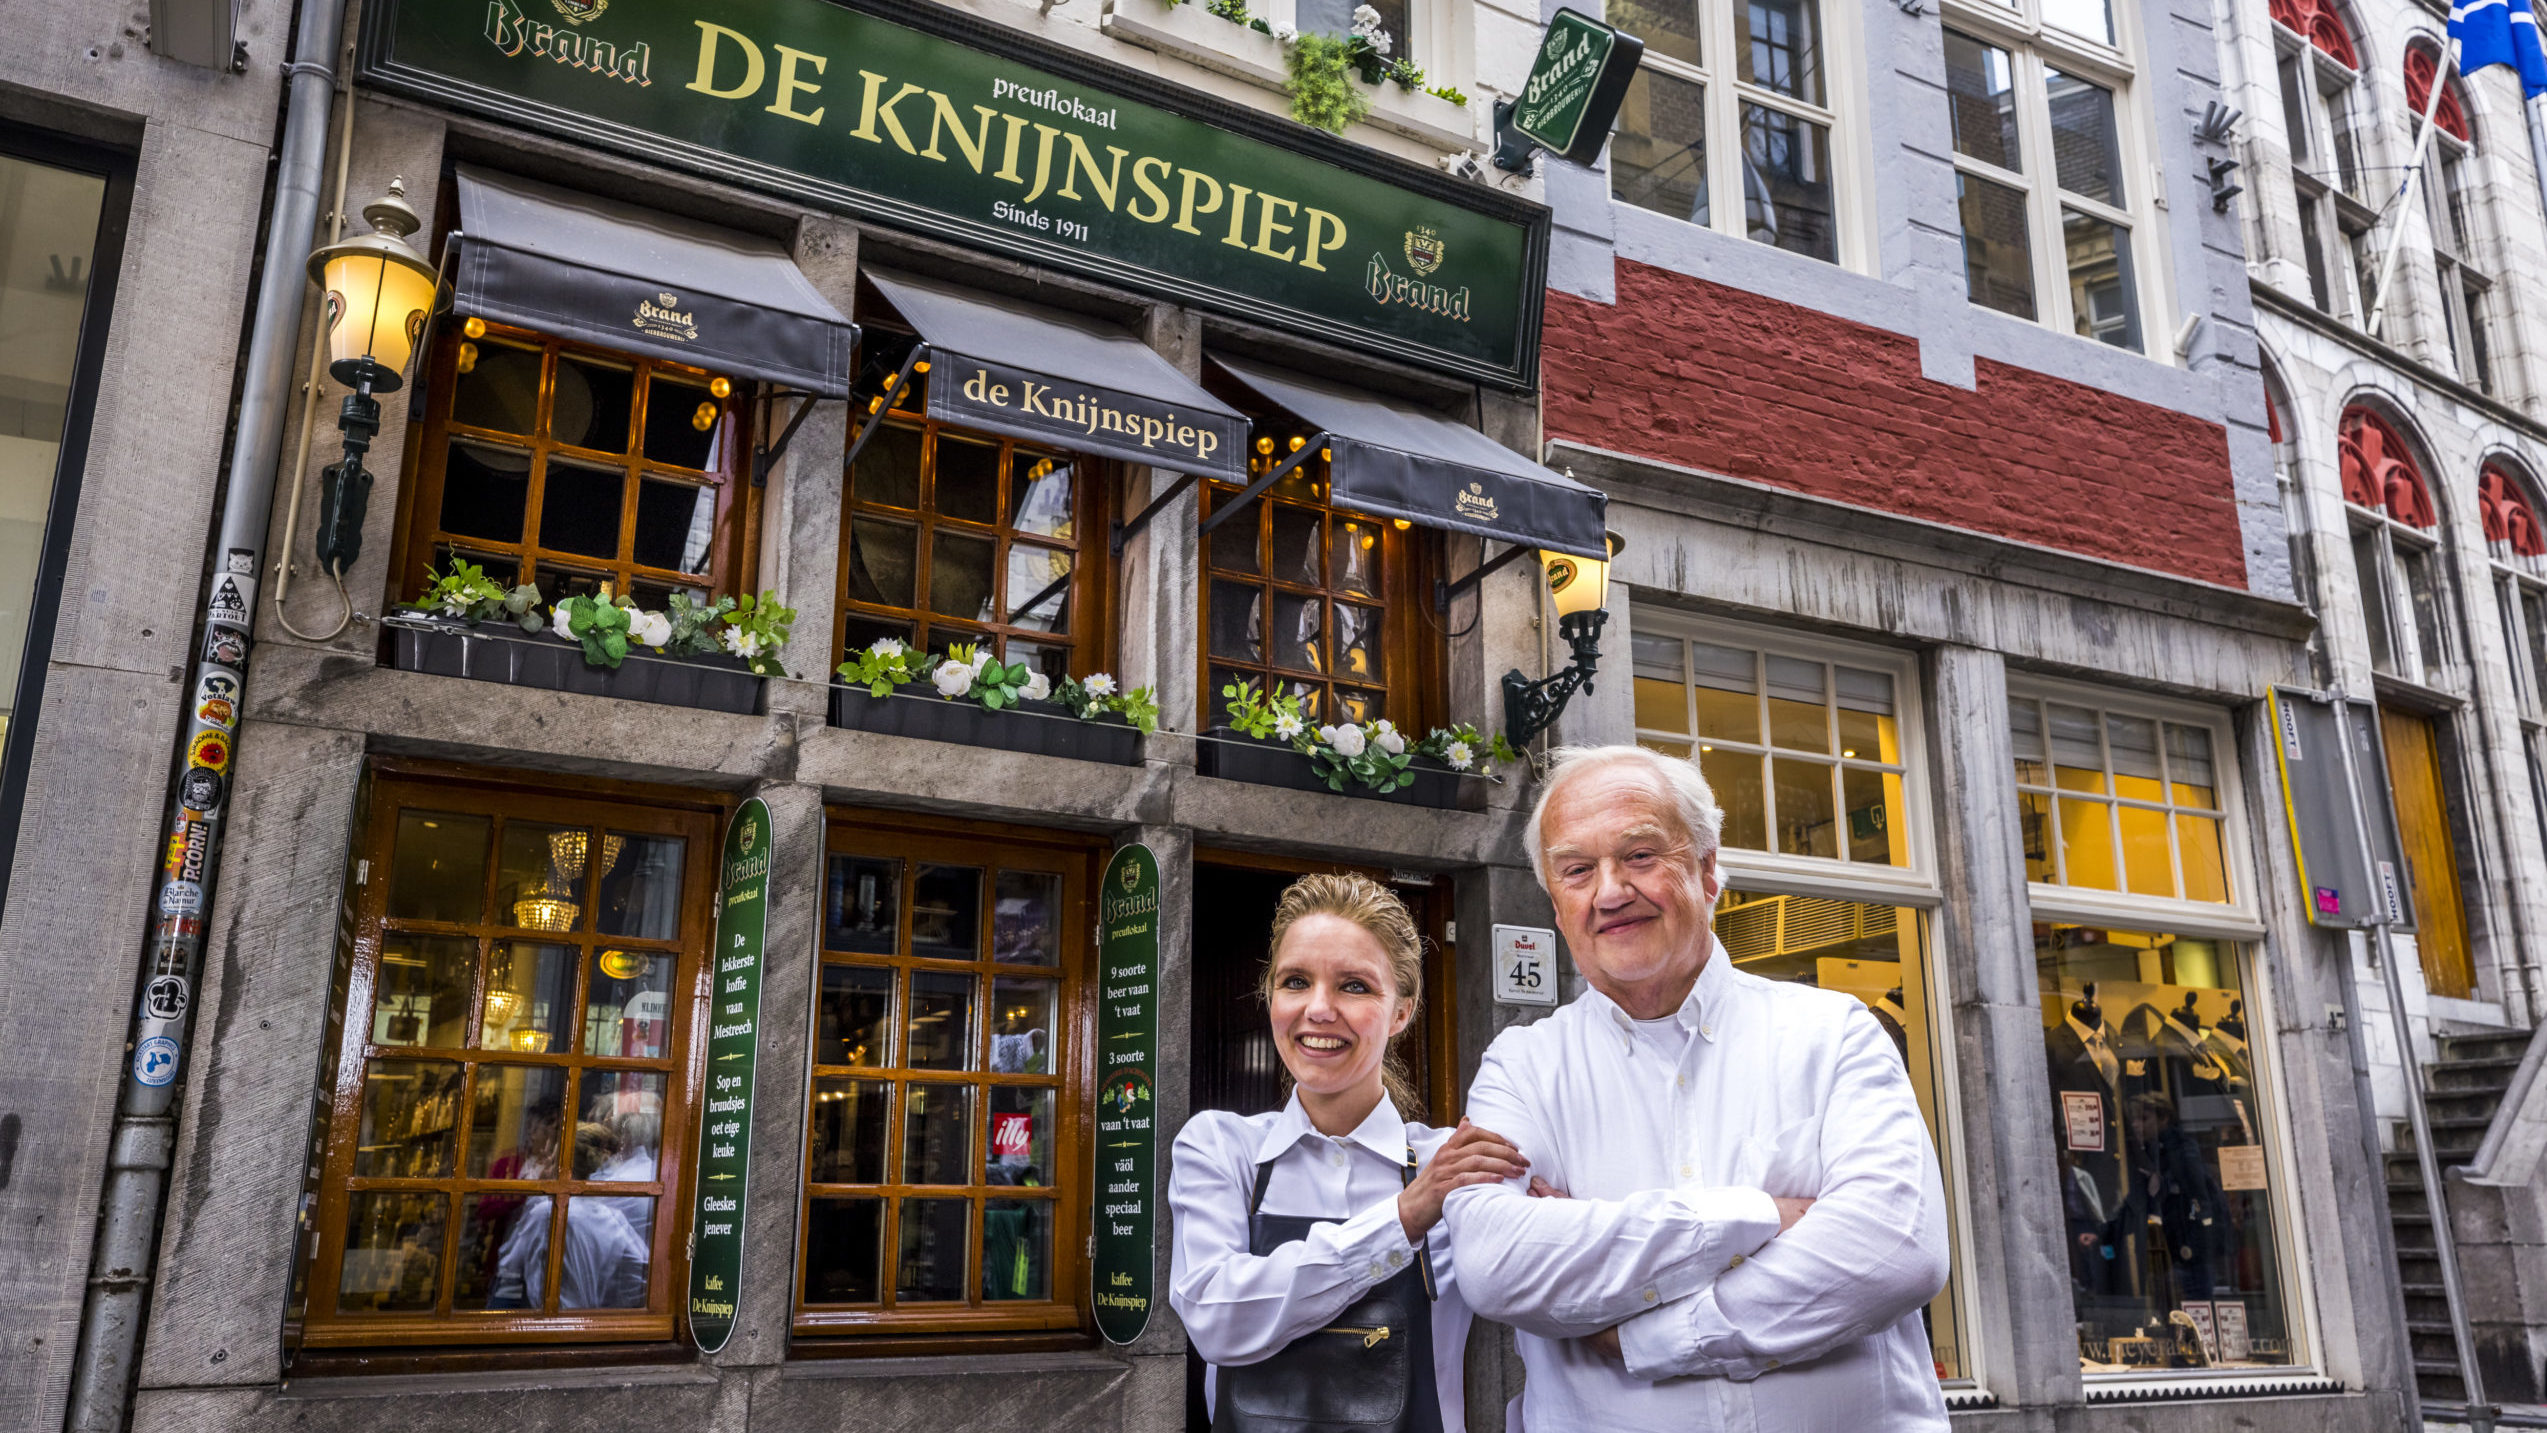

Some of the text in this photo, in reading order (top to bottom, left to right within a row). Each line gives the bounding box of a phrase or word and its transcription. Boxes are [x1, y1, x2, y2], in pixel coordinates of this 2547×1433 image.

[484, 0, 652, 87] Brand
[1528, 31, 1591, 104] Brand
[992, 77, 1117, 130] preuflokaal
[685, 20, 1348, 273] DE KNIJNSPIEP
[992, 201, 1088, 242] Sinds 1911
[1365, 251, 1471, 322] Brand
[640, 300, 694, 326] Brand
[963, 369, 1218, 460] de Knijnspiep
[1458, 489, 1495, 508] Brand
[725, 847, 768, 890] Brand
[1104, 886, 1157, 924] Brand
[734, 934, 745, 948] De
[1515, 940, 1536, 950] Duvel
[721, 954, 755, 973] lekkerste
[1111, 963, 1146, 979] 9 soorte
[1510, 961, 1542, 988] 45
[726, 977, 747, 994] koffie
[1107, 982, 1149, 999] beer vaan
[725, 1000, 743, 1015] vaan
[1121, 1003, 1141, 1017] vaat
[713, 1019, 752, 1040] Mestreech
[1108, 1049, 1145, 1065] 3 soorte
[717, 1074, 741, 1090] Sop en
[709, 1097, 745, 1113] bruudsjes
[712, 1120, 740, 1138] oet eige
[1101, 1118, 1121, 1131] vaan
[1131, 1116, 1150, 1130] vaat
[995, 1117, 1030, 1151] illy
[712, 1144, 735, 1159] keuke
[1114, 1157, 1134, 1172] väöl
[1108, 1180, 1140, 1194] aander
[704, 1196, 736, 1212] Gleeskes
[1105, 1200, 1142, 1216] speciaal
[704, 1220, 732, 1238] jenever
[1113, 1222, 1134, 1236] beer
[705, 1275, 723, 1291] kaffee
[1111, 1271, 1133, 1287] kaffee
[692, 1297, 733, 1319] De Knijnspiep
[1097, 1293, 1147, 1312] De Knijnspiep
